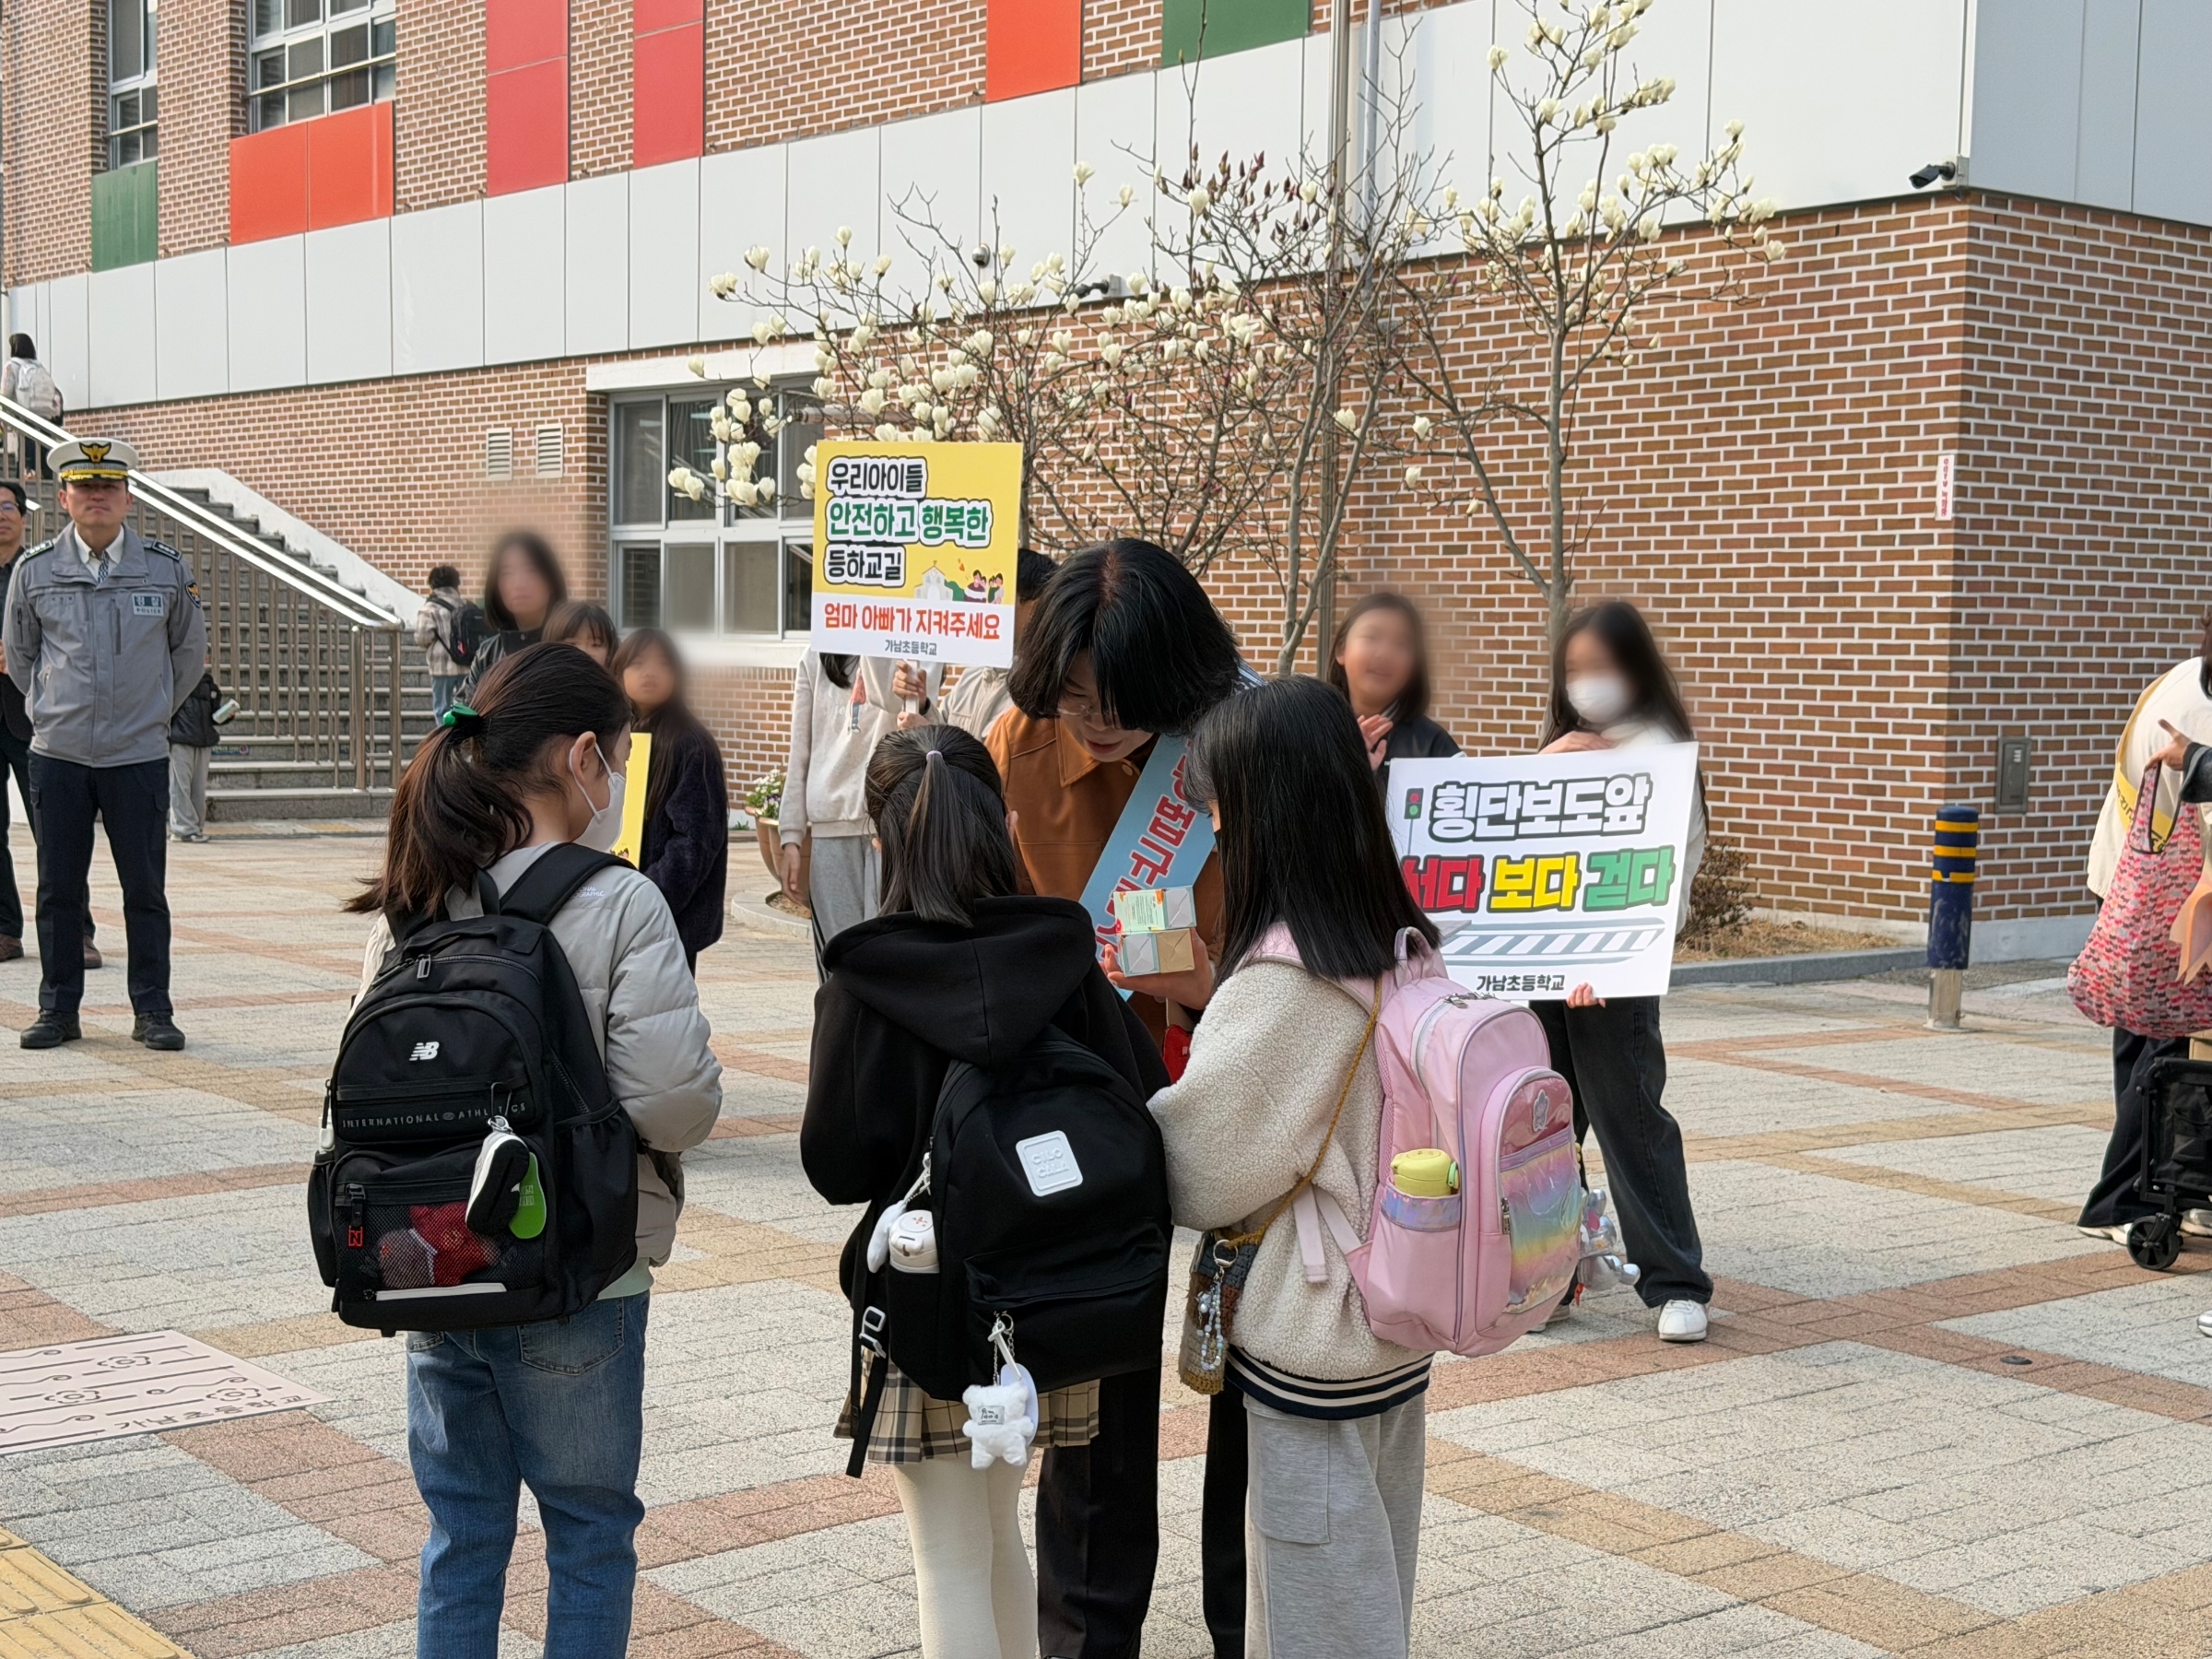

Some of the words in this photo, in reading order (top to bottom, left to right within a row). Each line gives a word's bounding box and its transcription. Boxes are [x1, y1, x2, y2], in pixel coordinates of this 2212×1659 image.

[830, 463, 924, 493] 우리아이들
[830, 502, 916, 537] 안전하고
[922, 505, 989, 541] 행복한
[828, 549, 901, 581] 등하교길
[824, 602, 858, 629] 엄마
[861, 605, 912, 633] 아빠가
[915, 609, 1000, 641] 지켜주세요
[885, 640, 937, 655] 가남초등학교
[1430, 773, 1653, 842] 횡단보도앞
[1402, 854, 1486, 913] 서다
[1487, 852, 1582, 912] 보다
[1583, 845, 1676, 912] 걷다
[1477, 974, 1565, 992] 가남초등학교
[342, 1113, 439, 1128] INTERNATIONAL
[458, 1102, 525, 1120] ATHLTCS
[114, 1395, 312, 1430] 가남초등학교
